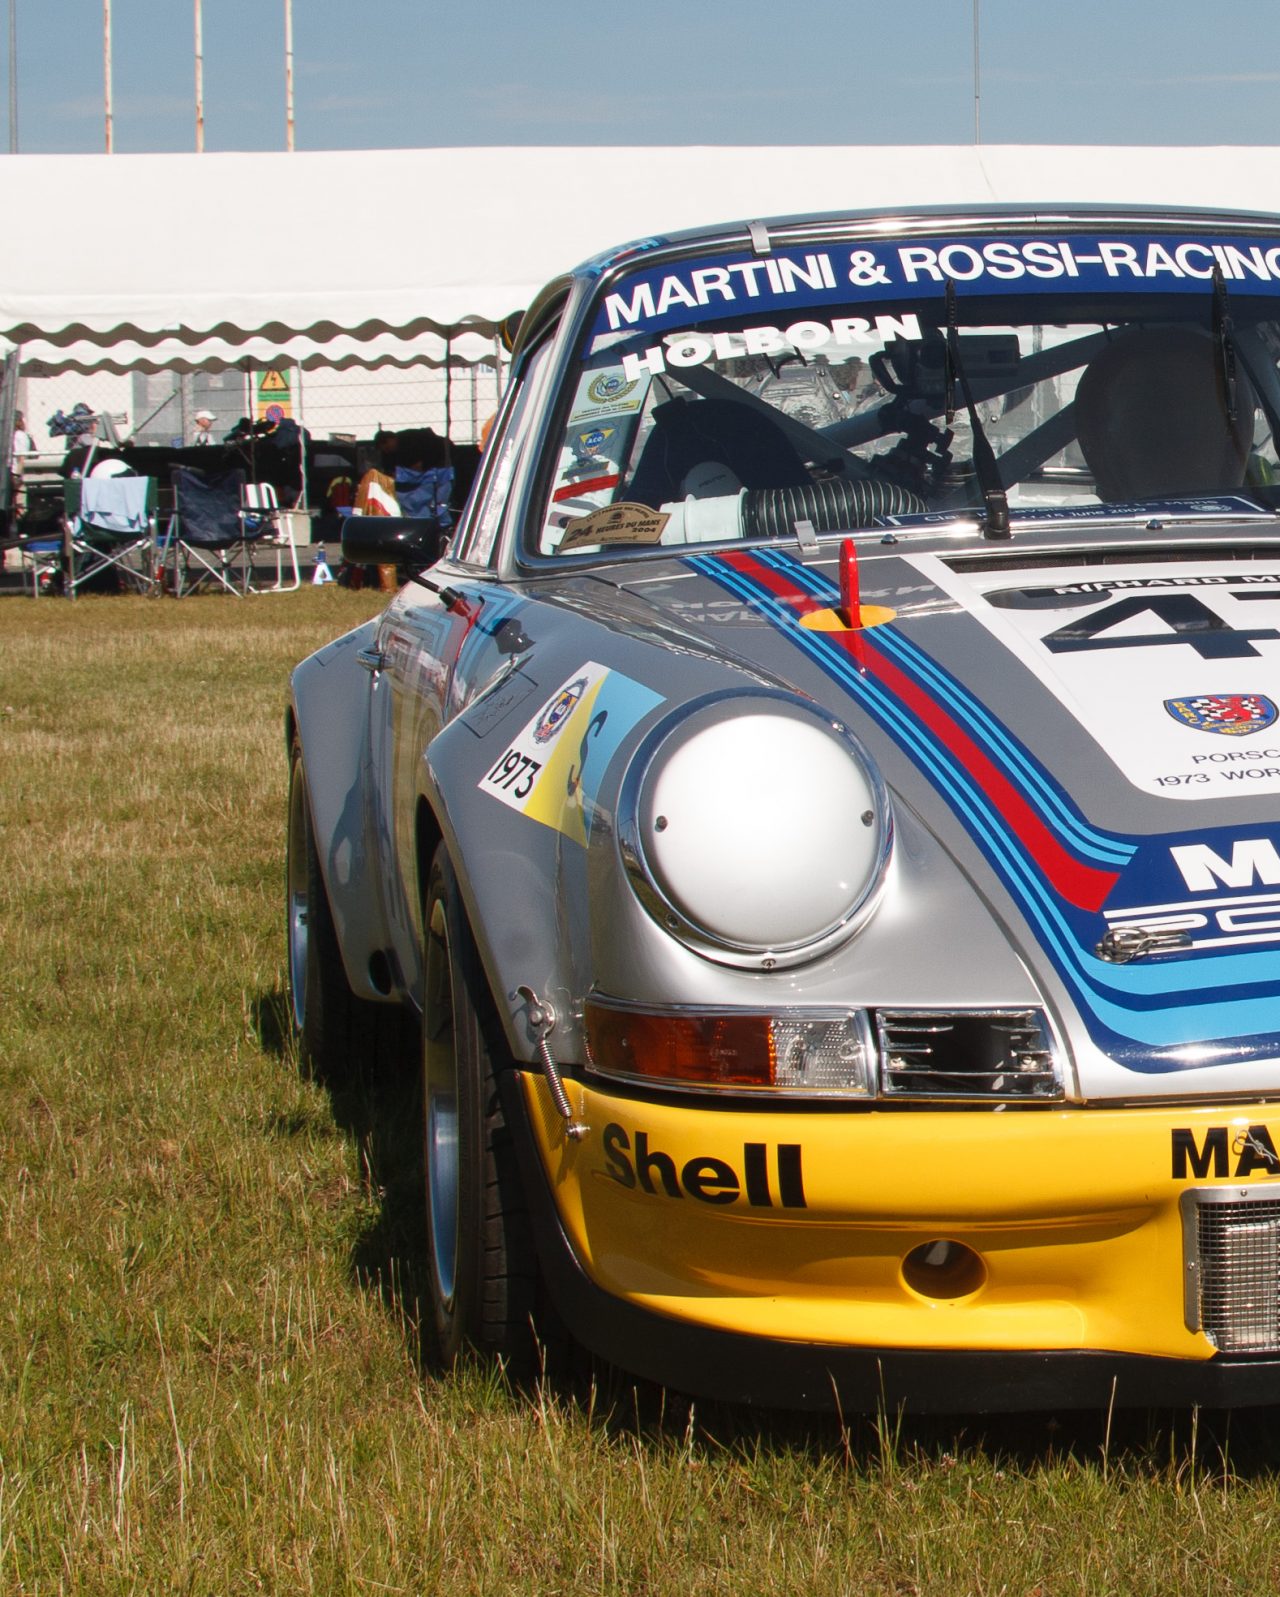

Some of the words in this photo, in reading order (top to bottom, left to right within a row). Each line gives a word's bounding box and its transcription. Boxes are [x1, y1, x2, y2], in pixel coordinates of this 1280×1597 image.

[605, 254, 838, 330] MARTINI
[849, 249, 892, 287] &
[621, 313, 923, 383] HOLBORN
[595, 523, 624, 534] HEURES
[625, 521, 637, 529] DU
[1068, 510, 1105, 518] June
[486, 749, 543, 799] 1973
[1153, 773, 1212, 787] 1973
[603, 1122, 808, 1208] Shell
